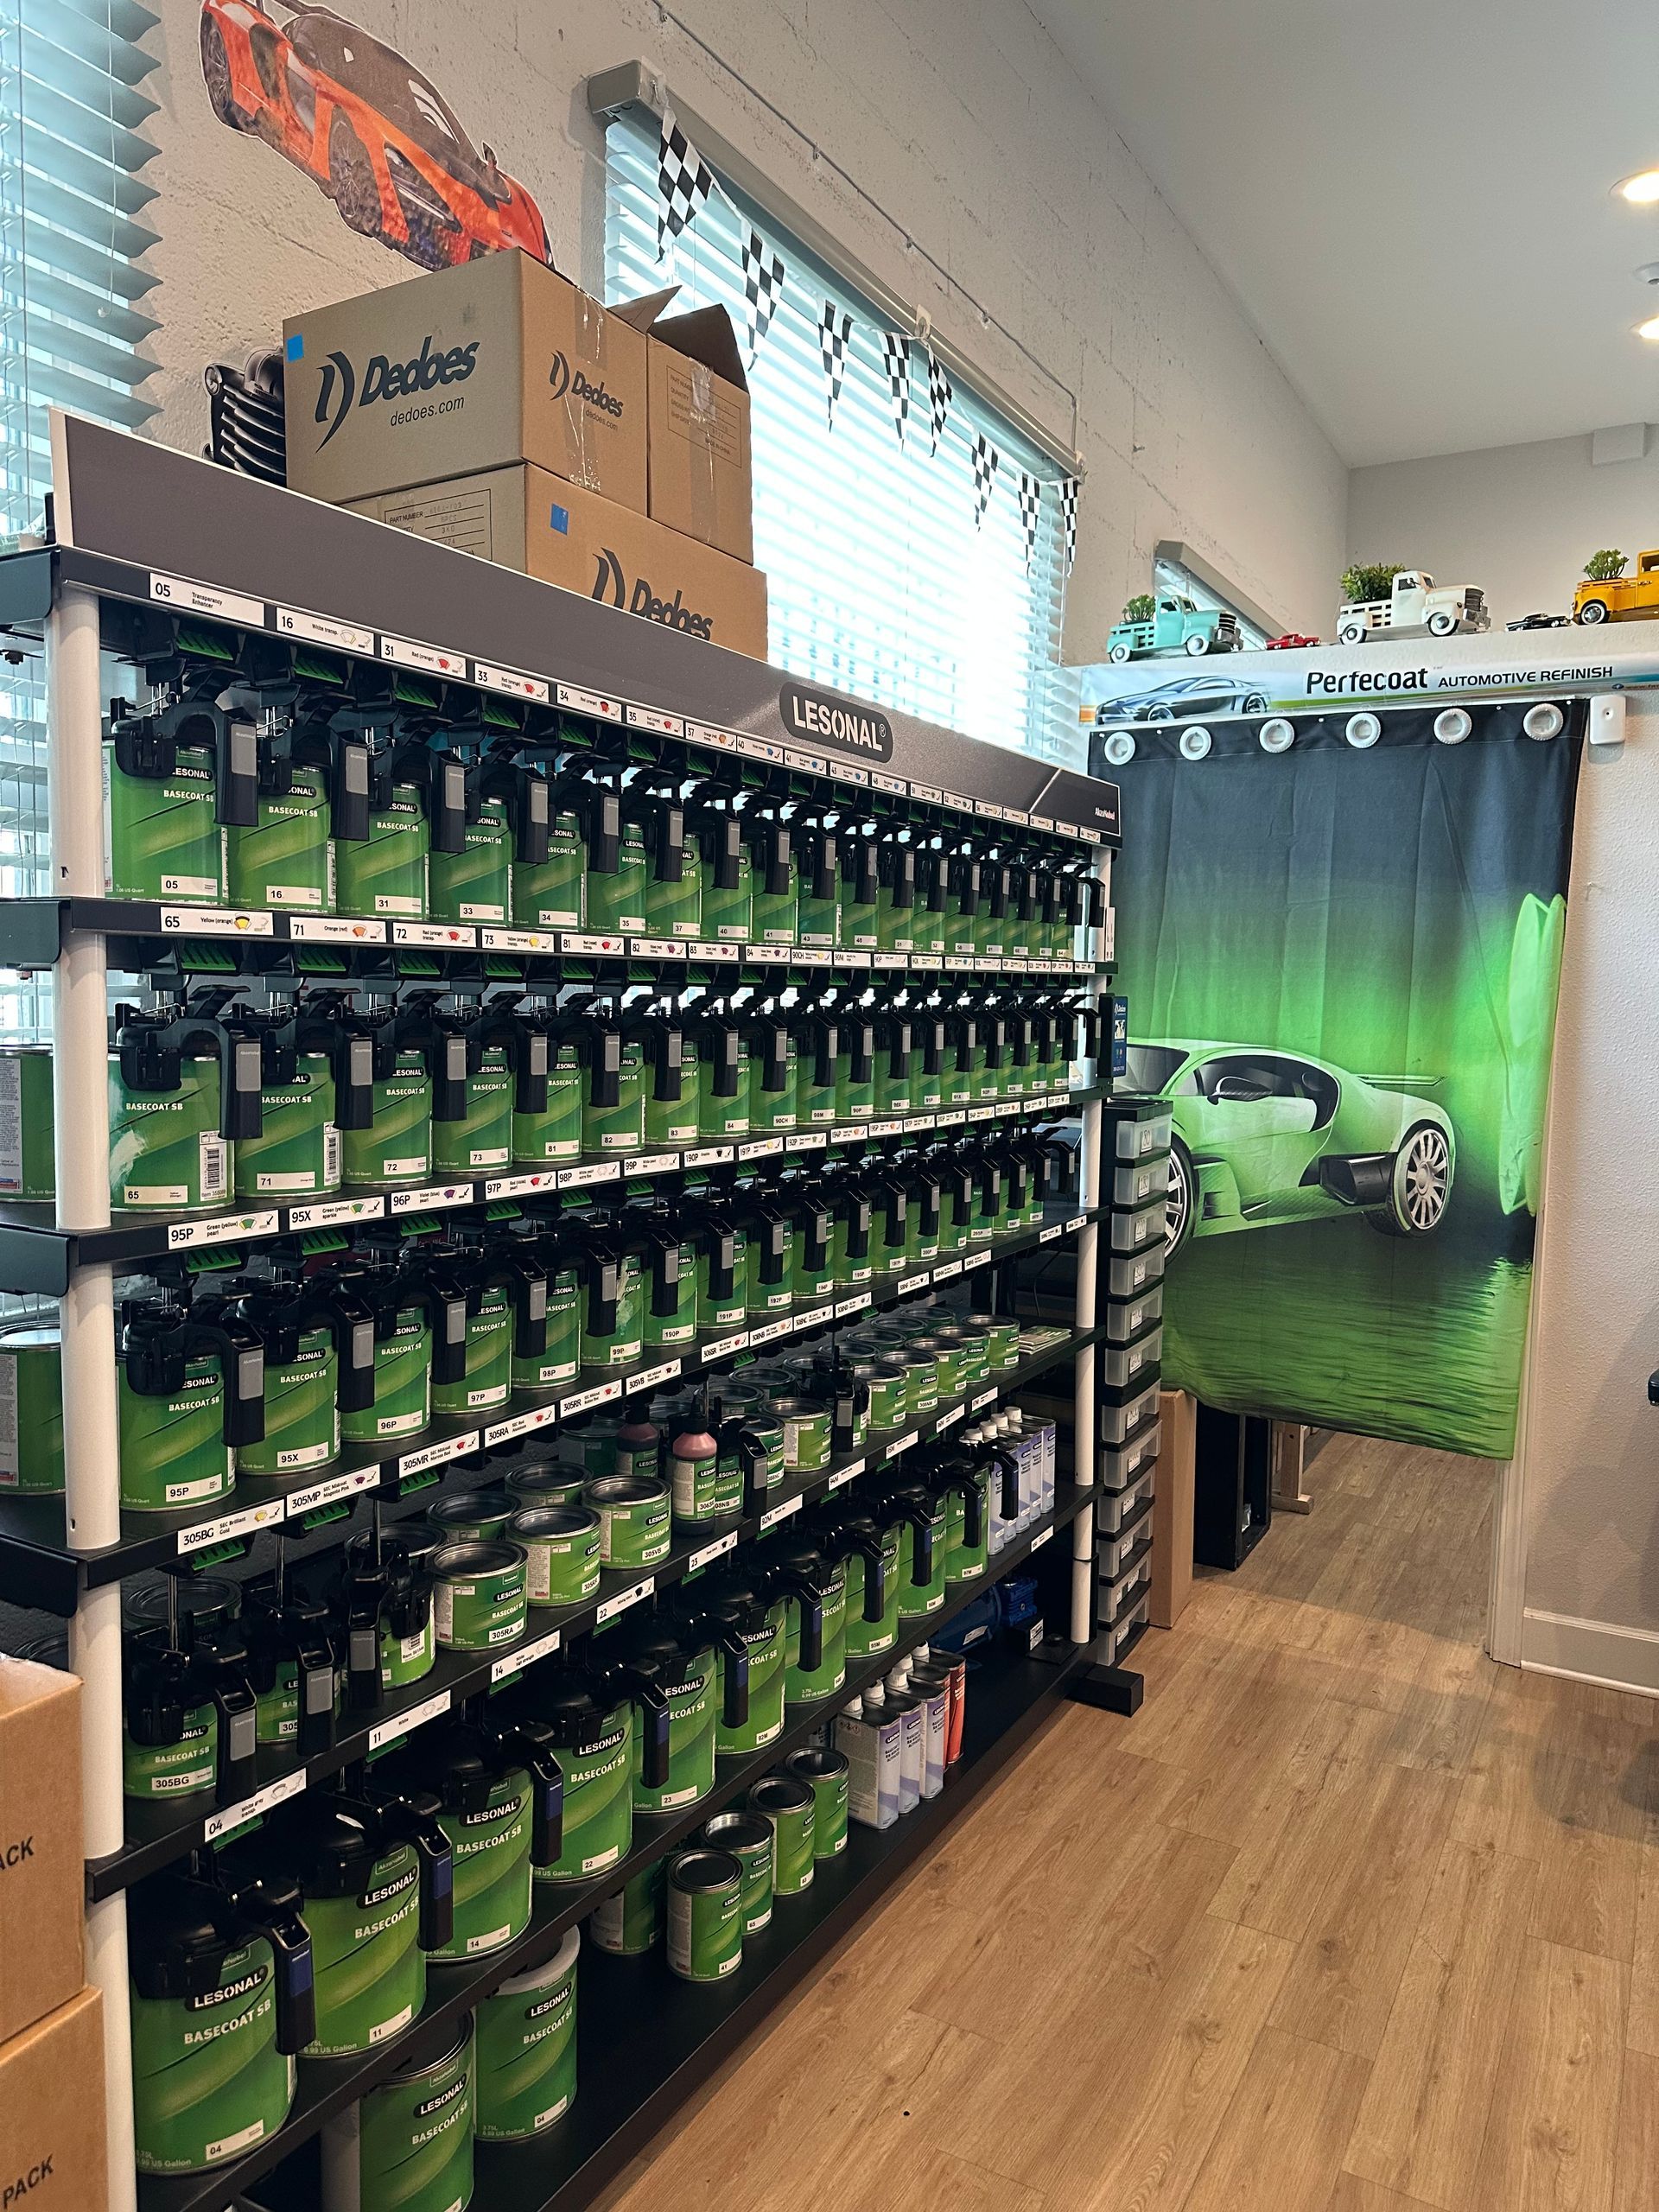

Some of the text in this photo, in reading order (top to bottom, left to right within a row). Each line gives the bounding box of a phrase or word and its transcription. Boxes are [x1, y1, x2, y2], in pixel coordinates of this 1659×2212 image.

[358, 335, 481, 408] Dedoes
[571, 370, 624, 418] Dedoes
[390, 395, 465, 428] dedoes.com
[585, 408, 619, 432] dedoes.com
[389, 511, 423, 524] PART NUMBER
[155, 582, 171, 597] 05
[629, 577, 715, 641] Dedoes
[281, 615, 294, 629] 16
[311, 623, 323, 632] White
[385, 645, 395, 657] 31
[478, 671, 488, 683] 33
[1306, 665, 1613, 696] Perfecoat AUTOMOTIVE REFINISH
[560, 690, 569, 702] 34
[628, 711, 637, 721] 35
[791, 695, 884, 753] LESONAL
[687, 728, 695, 737] 37
[737, 740, 745, 749] 40
[785, 754, 791, 763] 41
[163, 790, 205, 801] BASECOAT
[269, 806, 308, 817] BASECOAT
[377, 822, 412, 831] BASECOAT
[165, 880, 179, 889] 05
[270, 889, 283, 899] 16
[164, 915, 181, 929] 65
[215, 917, 233, 925] (orange)
[293, 924, 305, 936] 71
[396, 928, 408, 939] 72
[484, 934, 494, 945] 73
[563, 938, 571, 949] 81
[632, 944, 640, 953] 82
[690, 945, 697, 954] 83
[125, 1103, 169, 1111] BASECOAT
[740, 1147, 751, 1155] 191P
[685, 1153, 699, 1162] 190P
[625, 1161, 637, 1171] 99P
[558, 1173, 573, 1183] 98P
[486, 1183, 502, 1194] 97P
[128, 1191, 139, 1199] 65
[393, 1195, 410, 1206] 96P
[291, 1210, 312, 1224] 95X
[220, 1221, 238, 1230] (yellow)
[171, 1228, 194, 1242] 95P
[381, 1344, 415, 1355] BASECOAT
[280, 1372, 317, 1382] BASECOAT
[629, 1376, 645, 1389] 305VB
[168, 1400, 209, 1411] BASECOAT
[563, 1398, 582, 1412] 305RR
[381, 1421, 397, 1429] 96P
[488, 1427, 509, 1441] 305RA
[281, 1453, 299, 1463] 95X
[403, 1454, 429, 1471] 305MR
[830, 1476, 839, 1485] 94M
[169, 1485, 189, 1497] 95P
[291, 1491, 321, 1509] 305MP
[229, 1516, 246, 1526] Brilliant
[761, 1516, 772, 1525] 92M
[183, 1528, 214, 1545] 305BG
[645, 1548, 662, 1558] 305VB
[690, 1558, 698, 1567] 23
[497, 1586, 522, 1600] LESONAL
[599, 1608, 607, 1619] 22
[492, 1626, 514, 1639] 305RA
[495, 1665, 503, 1676] 14
[696, 1700, 705, 1711] SB
[373, 1731, 382, 1744] 11
[758, 1732, 768, 1741] 92M
[579, 1732, 621, 1756] LESONAL
[156, 1750, 197, 1763] BASECOAT
[570, 1754, 626, 1783] BASECOAT SB
[156, 1776, 189, 1789] 305BG
[467, 1802, 517, 1825] LESONAL
[208, 1821, 223, 1834] 04
[456, 1825, 522, 1853] BASECOAT SB
[378, 1852, 406, 1872] AkzoNobel
[584, 1860, 593, 1869] 22
[365, 1872, 415, 1906] LESONAL
[355, 1904, 409, 1939] BASECOAT
[194, 1974, 262, 2008] LESONAL
[531, 1988, 569, 2017] LESONAL
[184, 1999, 271, 2045] BASECOAT SB
[372, 2028, 382, 2037] 11
[523, 2016, 565, 2044] BASECOAT
[333, 2042, 357, 2053] Gallon
[421, 2080, 464, 2114] LESONAL
[412, 2110, 460, 2145] BASECOAT
[209, 2144, 222, 2155] 04
[164, 2158, 191, 2167] Gallon
[3, 2153, 54, 2209] PACK
